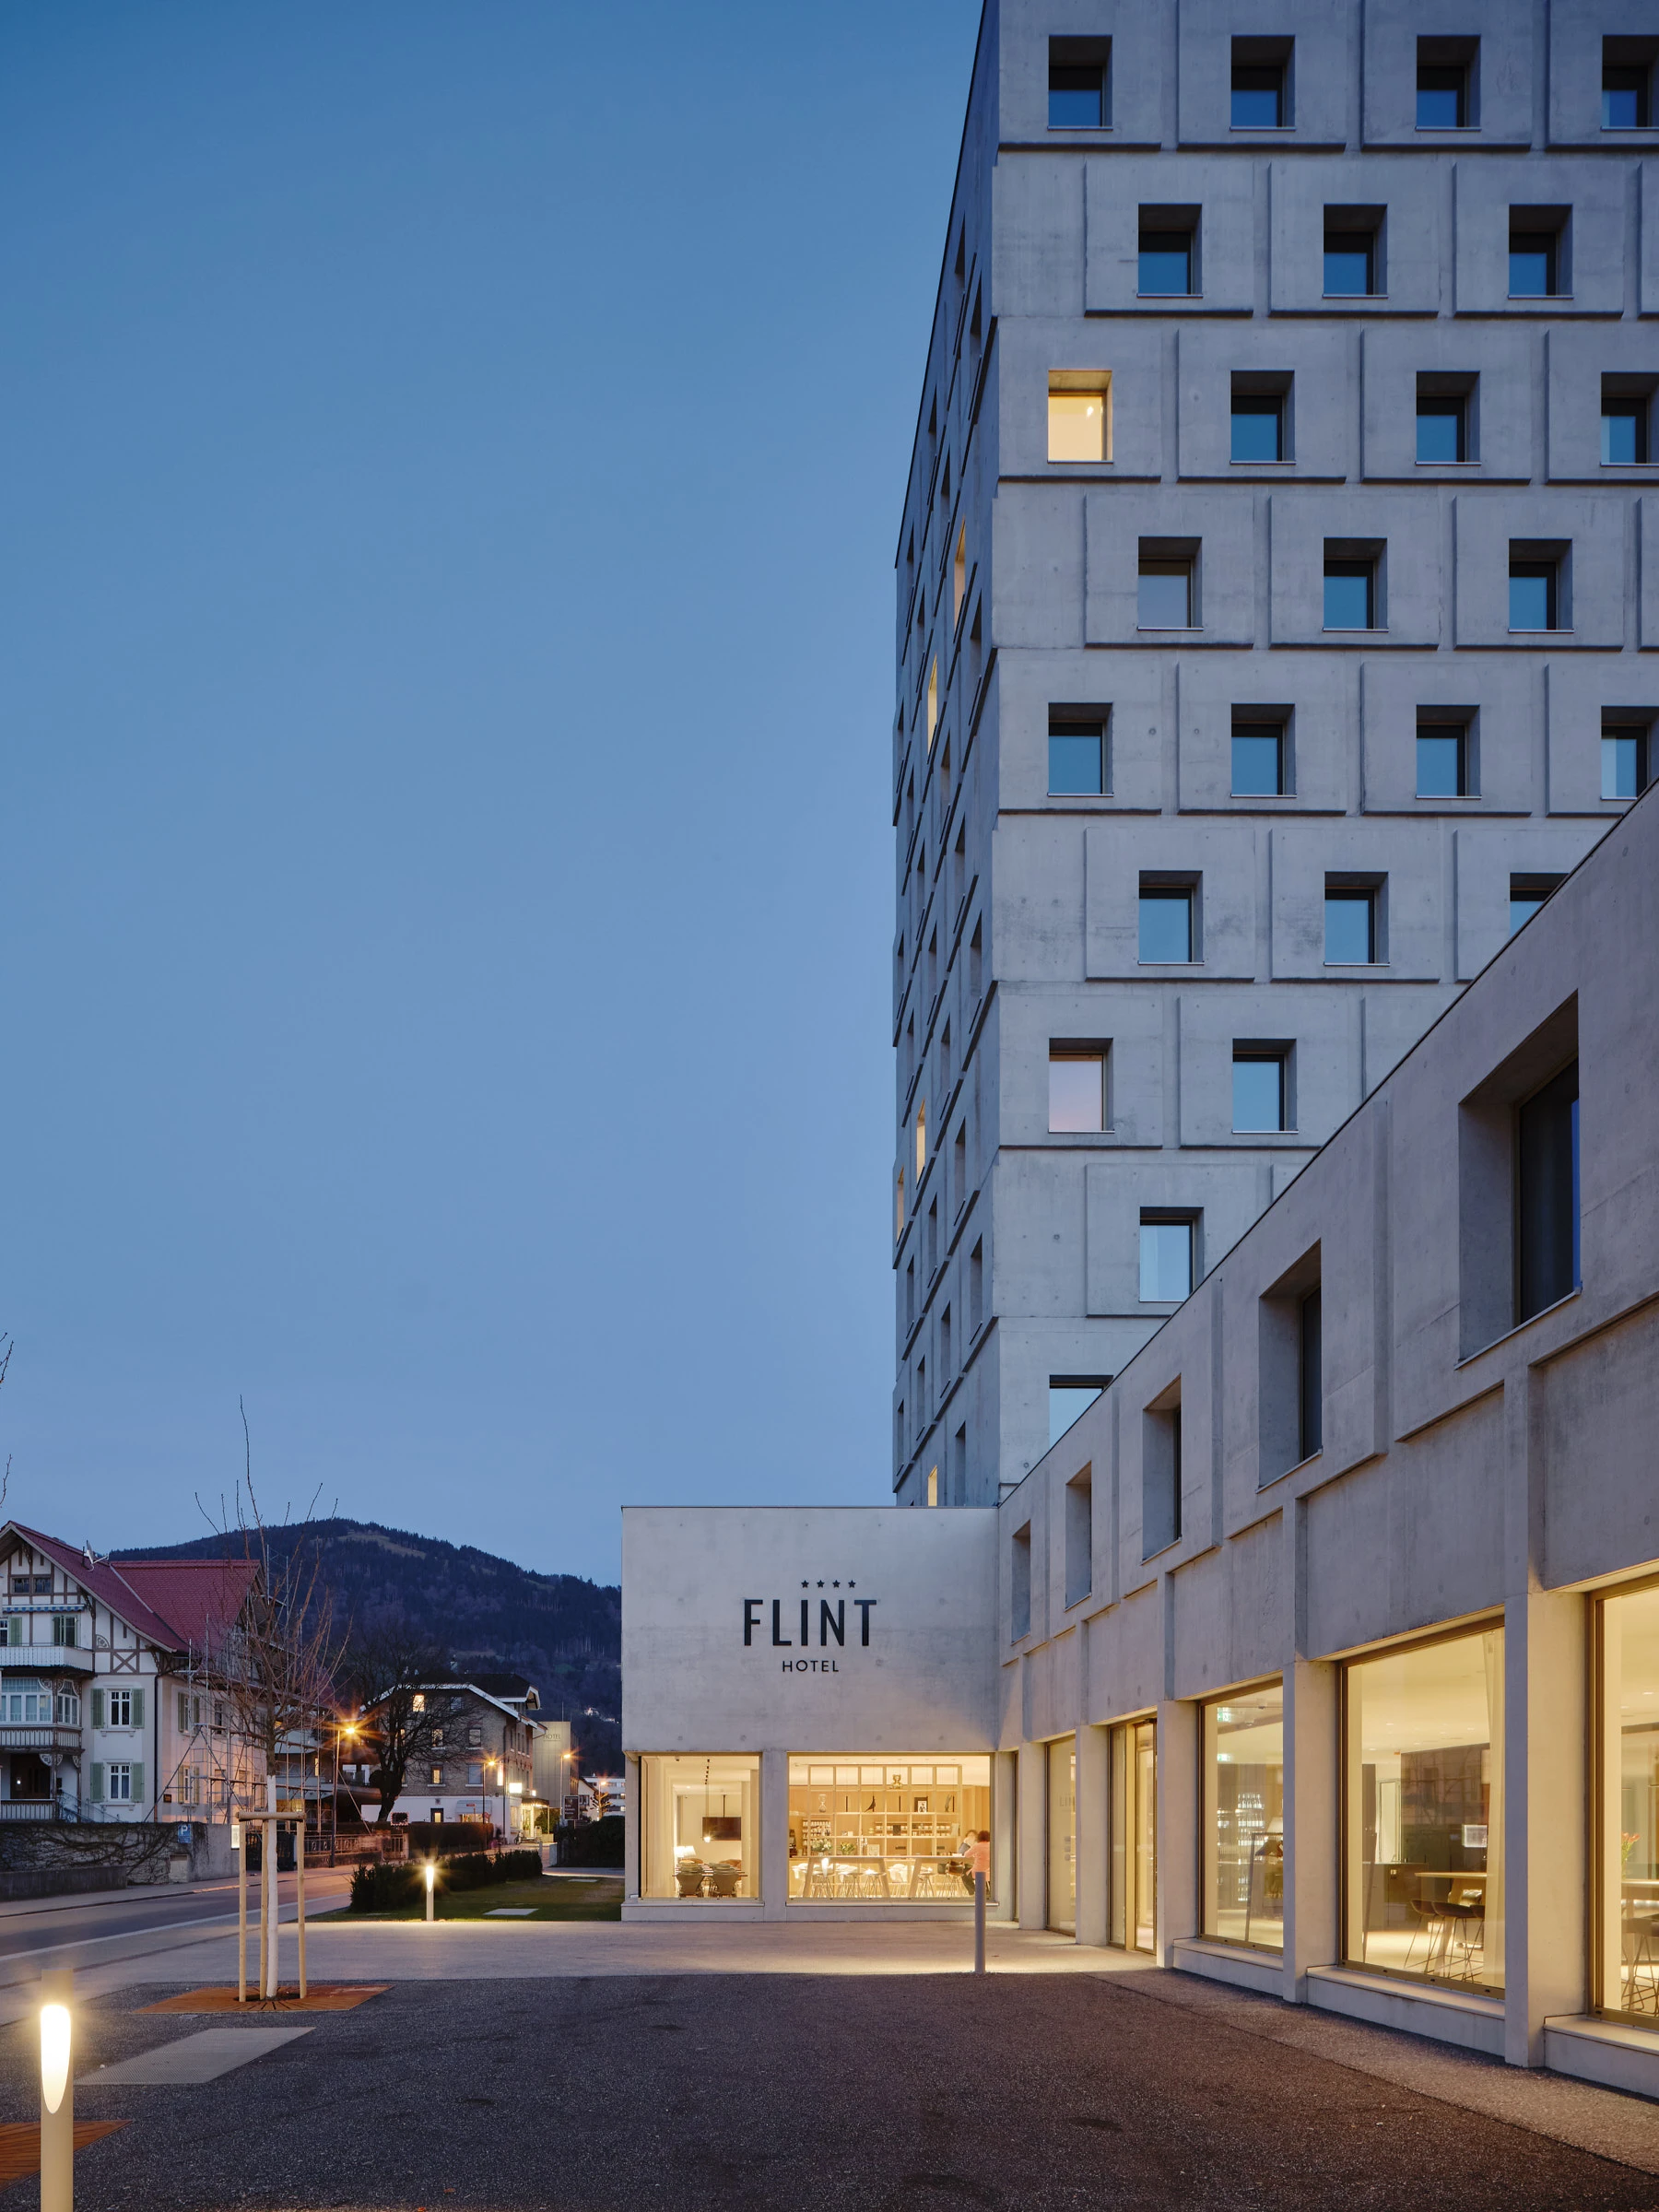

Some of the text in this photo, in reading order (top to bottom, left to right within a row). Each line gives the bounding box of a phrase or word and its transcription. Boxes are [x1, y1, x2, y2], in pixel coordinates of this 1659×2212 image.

[744, 1599, 877, 1647] FLINT
[782, 1659, 840, 1673] HOTEL
[181, 1825, 188, 1835] P
